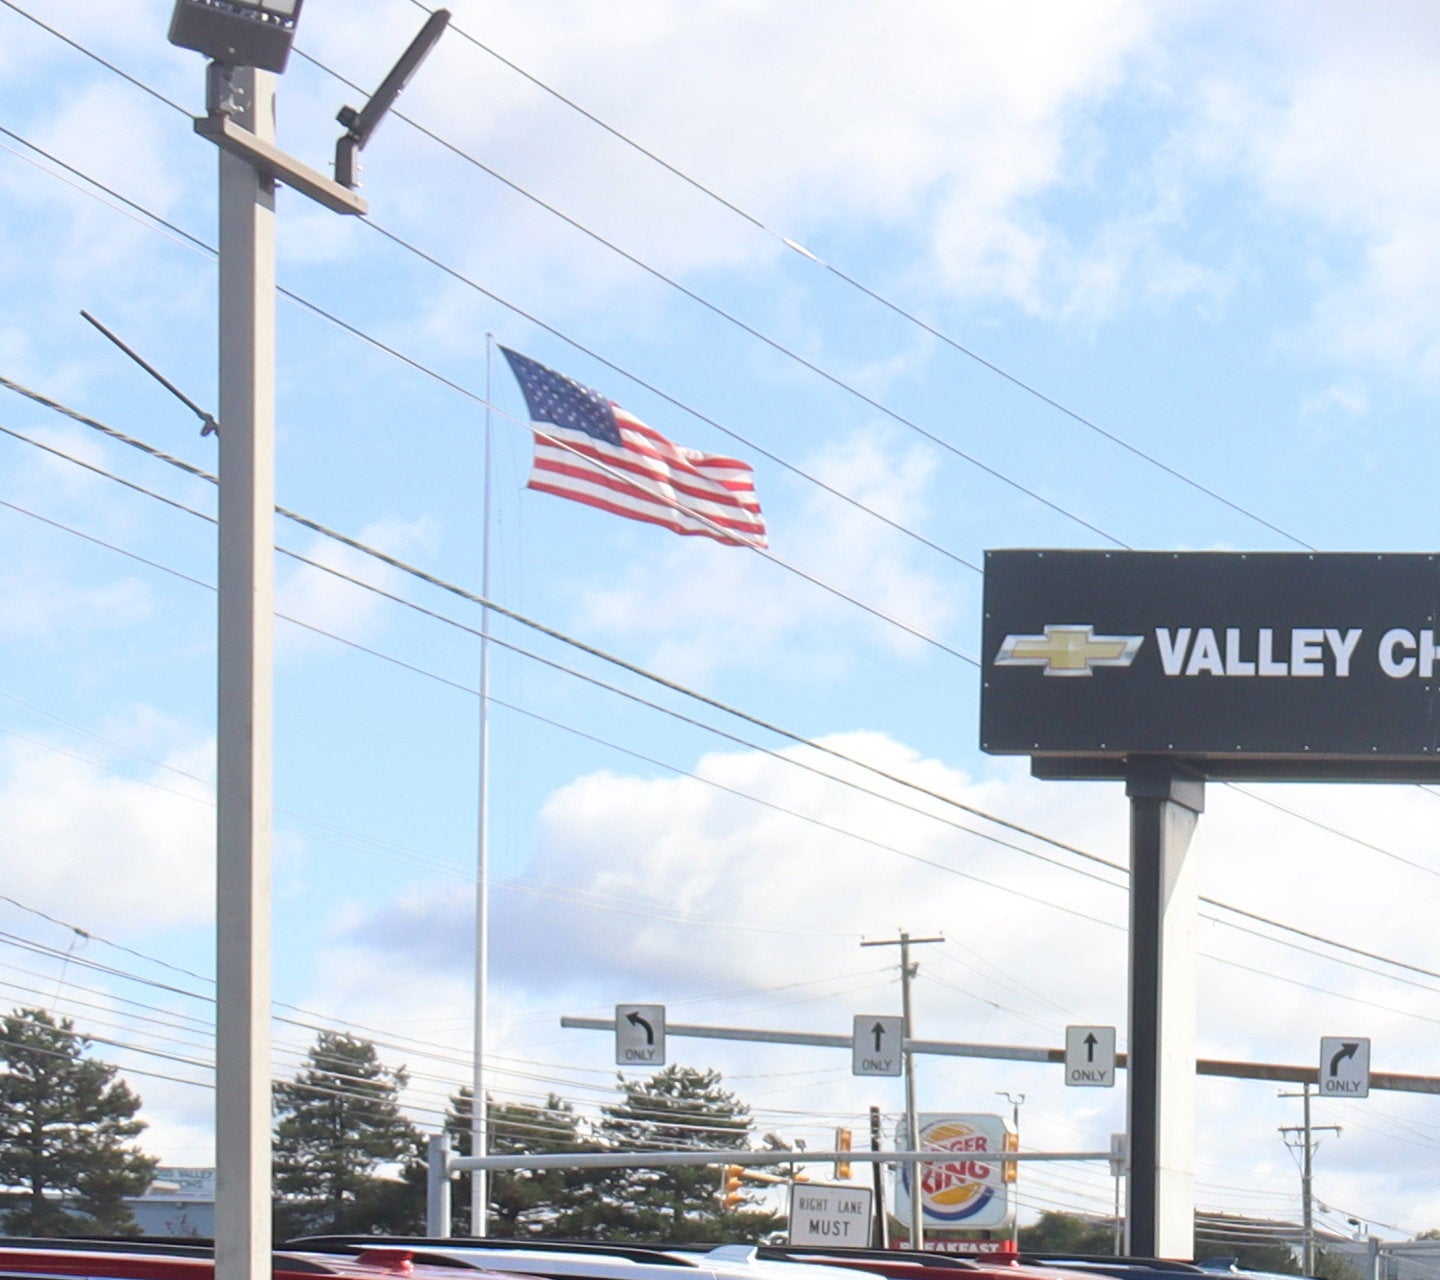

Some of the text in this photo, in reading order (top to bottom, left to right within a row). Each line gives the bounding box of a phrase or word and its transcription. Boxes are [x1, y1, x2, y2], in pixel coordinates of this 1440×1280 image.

[1156, 628, 1362, 677] VALLEY
[625, 1050, 655, 1061] ONLY
[861, 1059, 893, 1071] ONLY
[1071, 1070, 1107, 1081] ONLY
[1325, 1080, 1361, 1092] ONLY
[799, 1197, 863, 1215] RIGHT LANE
[808, 1219, 851, 1237] MUST
[899, 1242, 999, 1253] BEAKFAST
